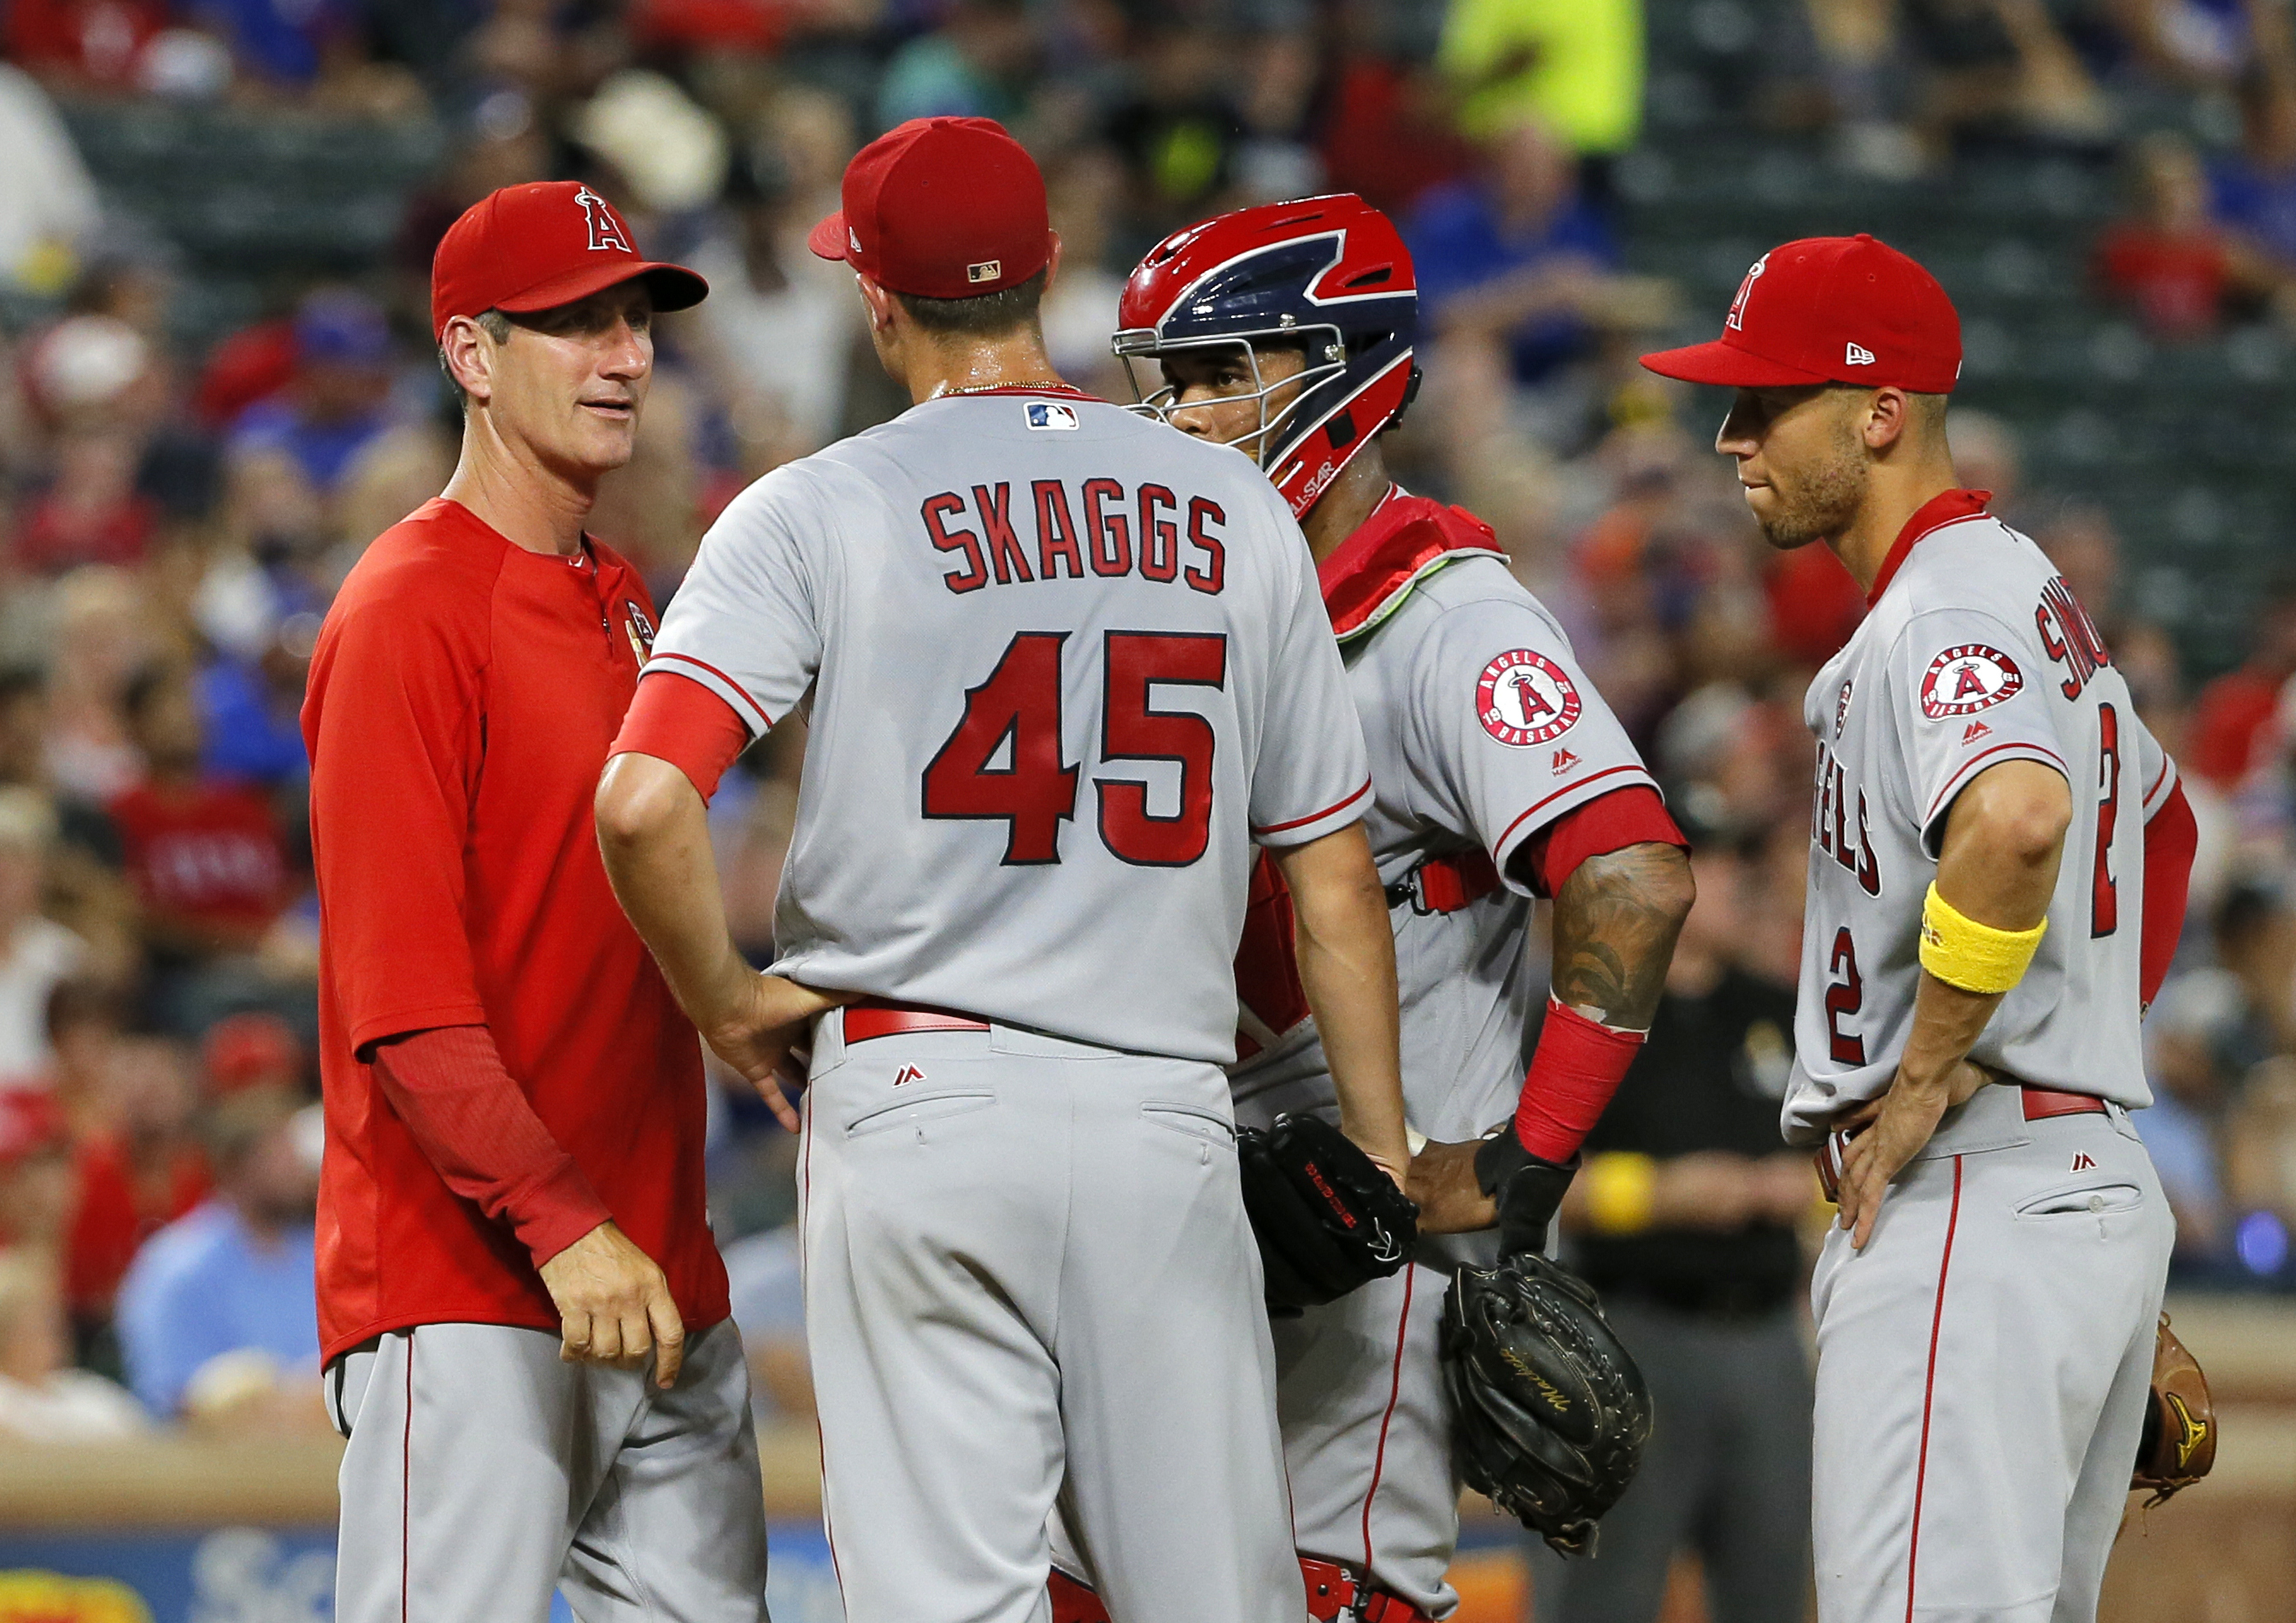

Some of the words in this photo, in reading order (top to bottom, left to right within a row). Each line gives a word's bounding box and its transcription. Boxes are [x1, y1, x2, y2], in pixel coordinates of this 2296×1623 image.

[574, 186, 632, 253] A
[1291, 461, 1335, 515] LL-STAR
[920, 477, 1226, 596] SKAGGS
[1480, 651, 1546, 689] ANGELS
[1929, 646, 2003, 675] ANGELS
[1483, 709, 1500, 726] 19
[1498, 702, 1580, 743] BASEBALL
[922, 630, 1227, 867] 45
[2091, 703, 2120, 939] 2
[1825, 926, 1867, 1067] 2
